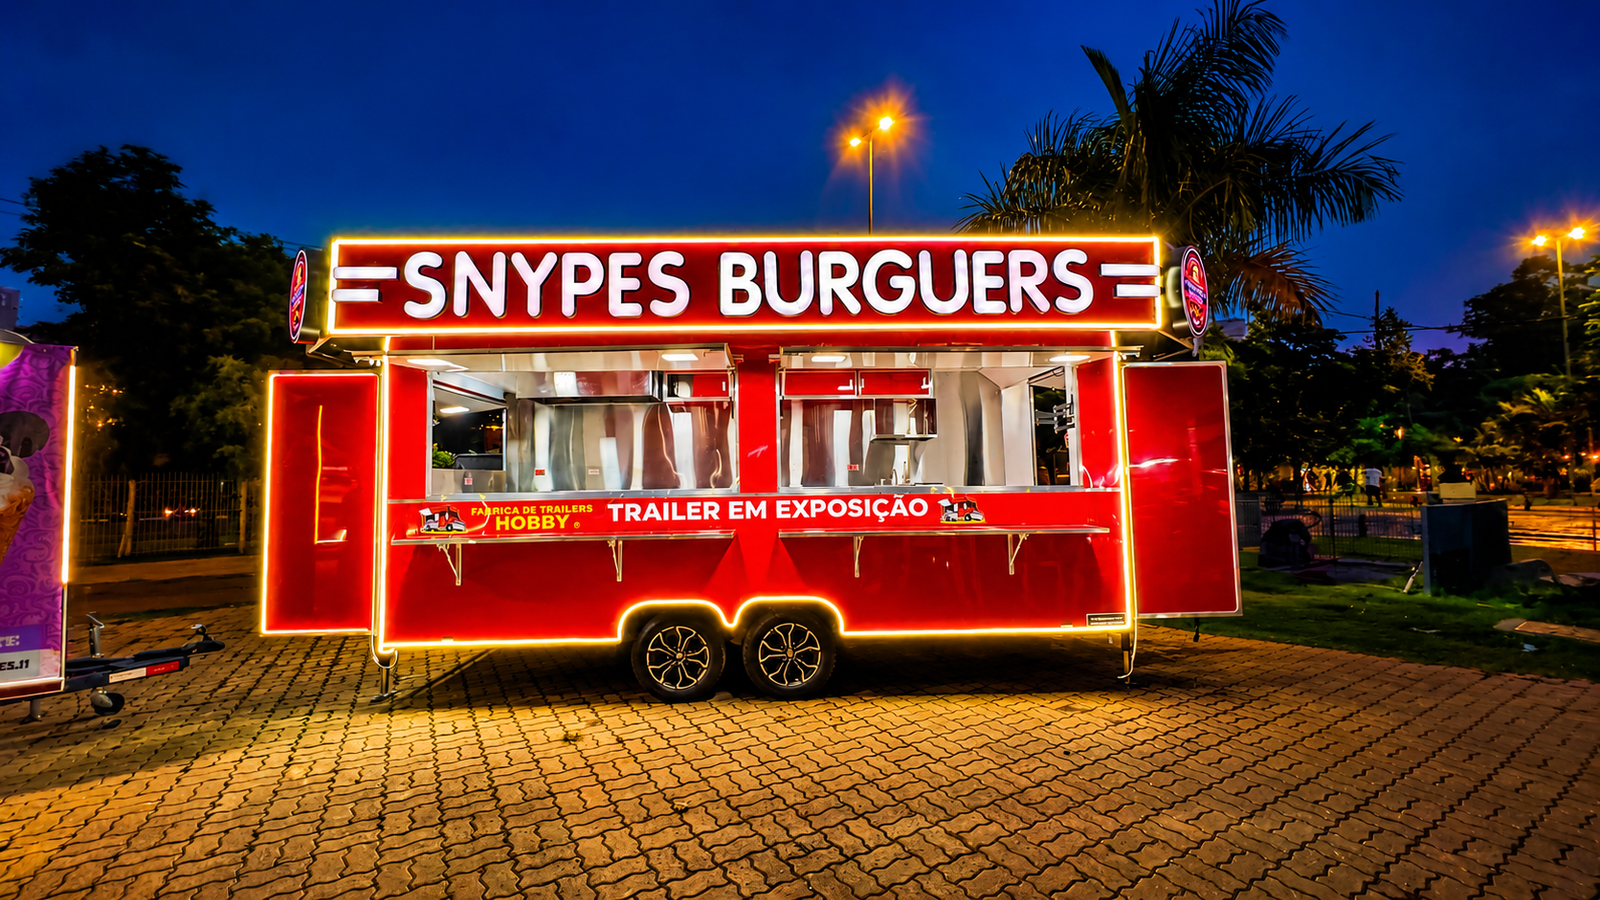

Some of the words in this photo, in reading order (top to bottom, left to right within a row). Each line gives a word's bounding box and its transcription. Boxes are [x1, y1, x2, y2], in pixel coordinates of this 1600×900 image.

[403, 250, 691, 318] SNYPES
[719, 248, 1094, 316] BURGUERS
[522, 505, 537, 515] DE
[540, 504, 593, 514] TRAILERS
[607, 502, 720, 522] TRAILER
[728, 500, 767, 520] EM
[776, 494, 928, 522] EXPOSIÇÃO
[495, 514, 570, 531] HOBBY
